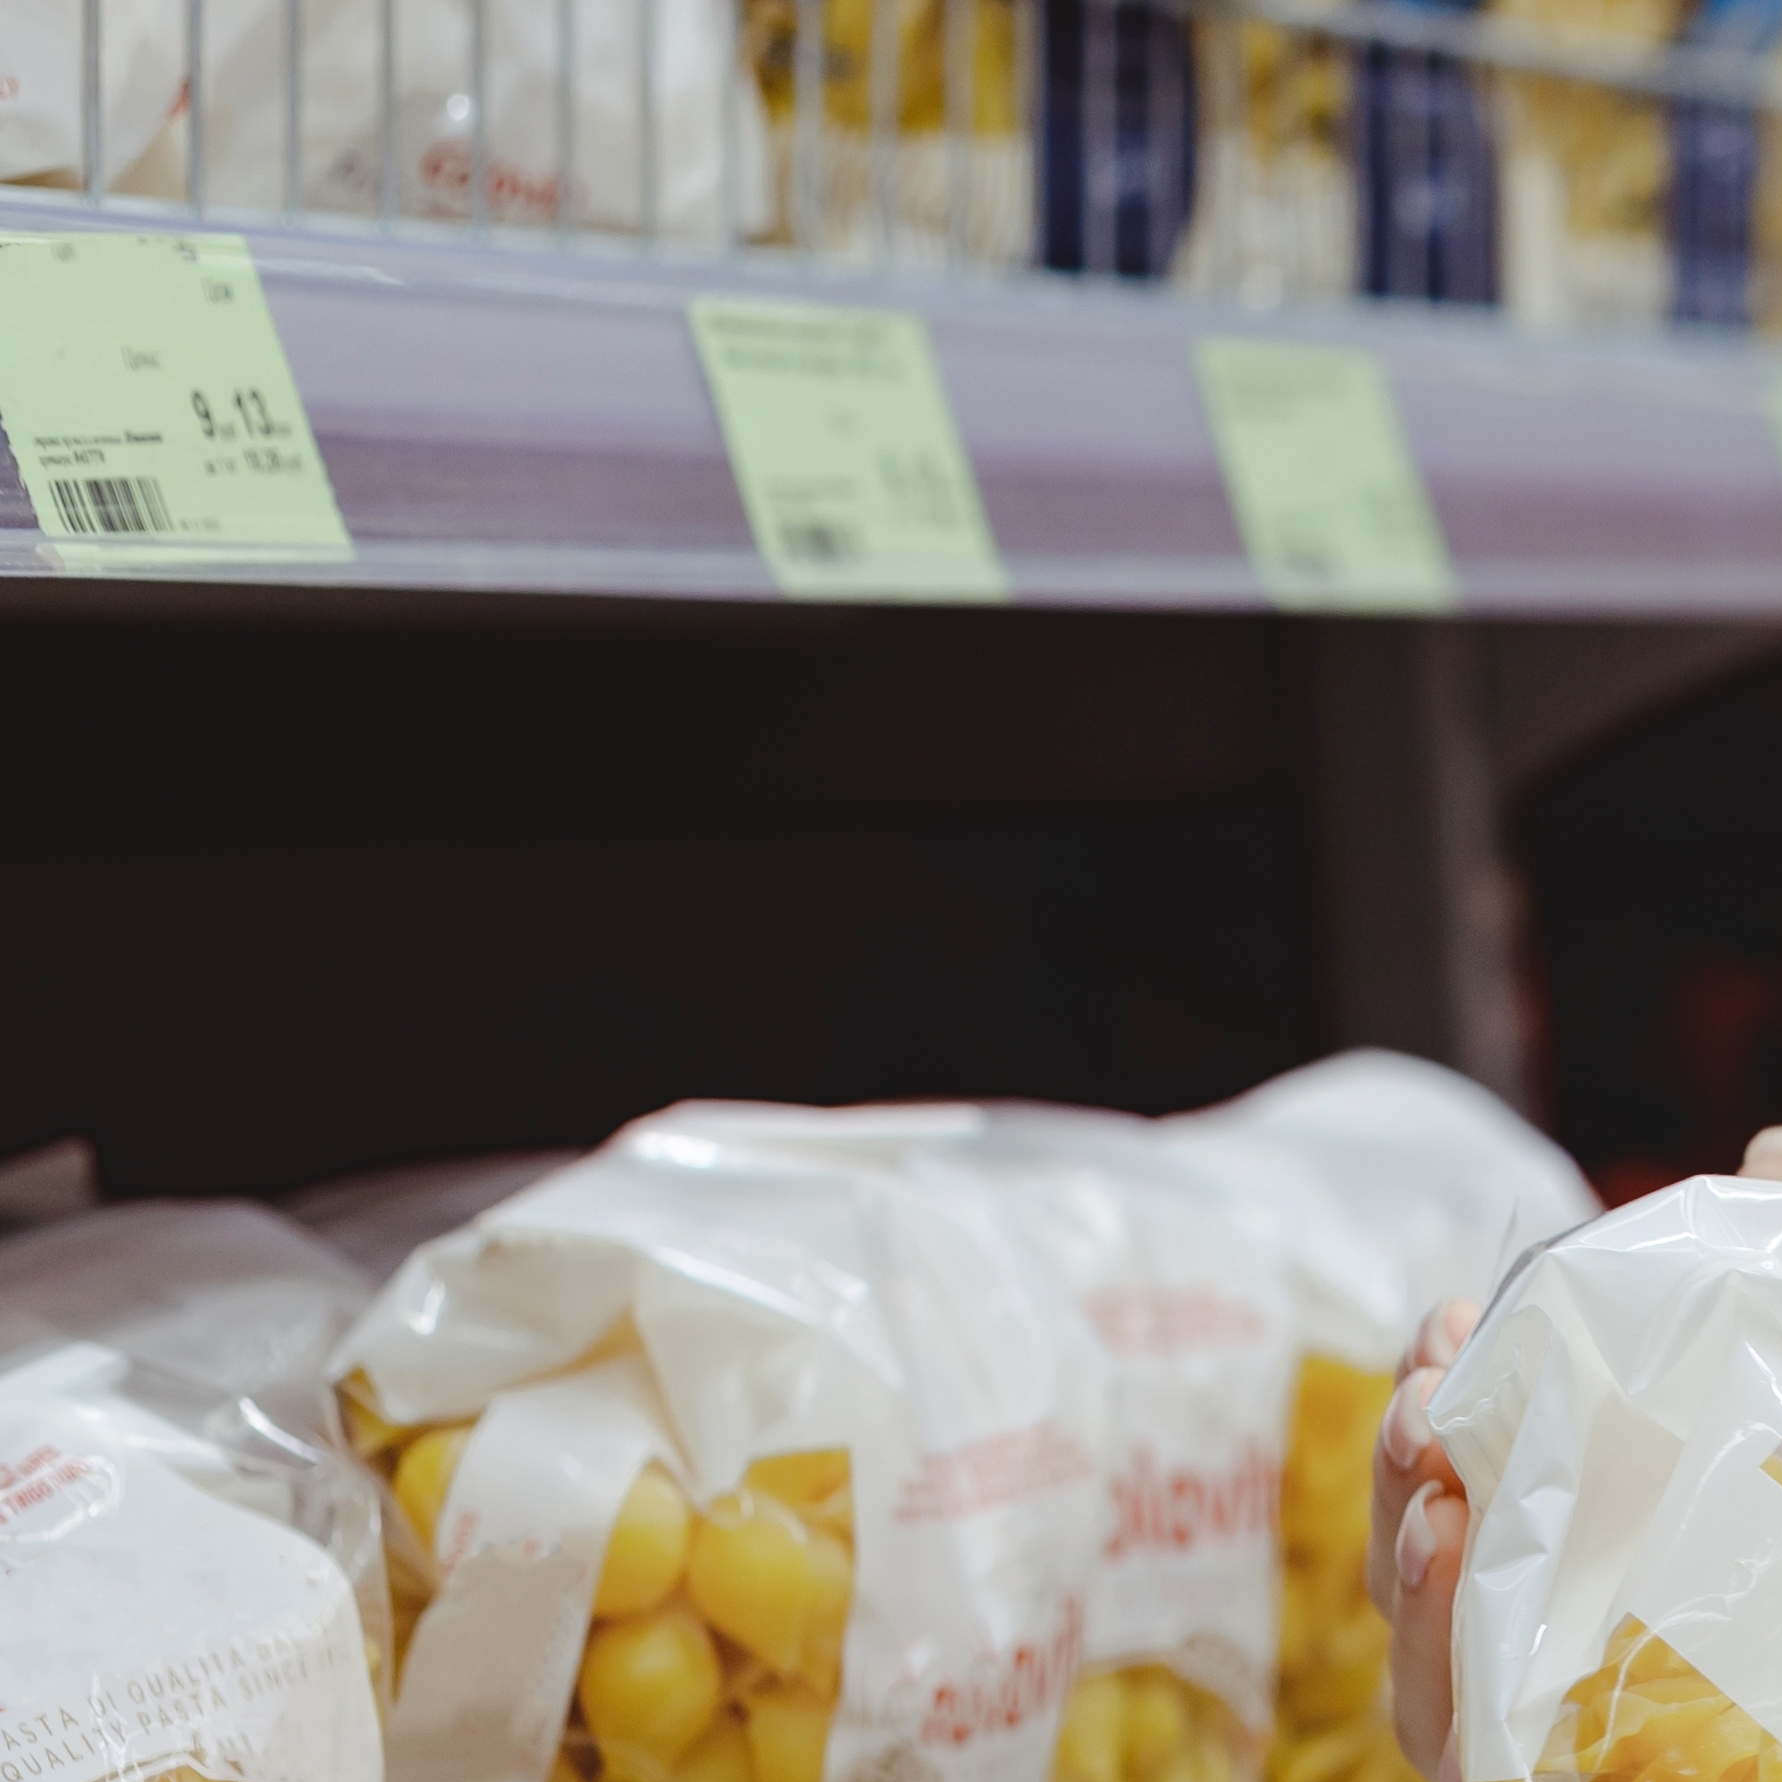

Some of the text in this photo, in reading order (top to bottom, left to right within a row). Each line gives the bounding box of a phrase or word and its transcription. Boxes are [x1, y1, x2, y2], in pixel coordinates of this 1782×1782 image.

[191, 388, 216, 438] 9
[0, 1706, 79, 1752] ASTA
[138, 1685, 228, 1736] PASTA
